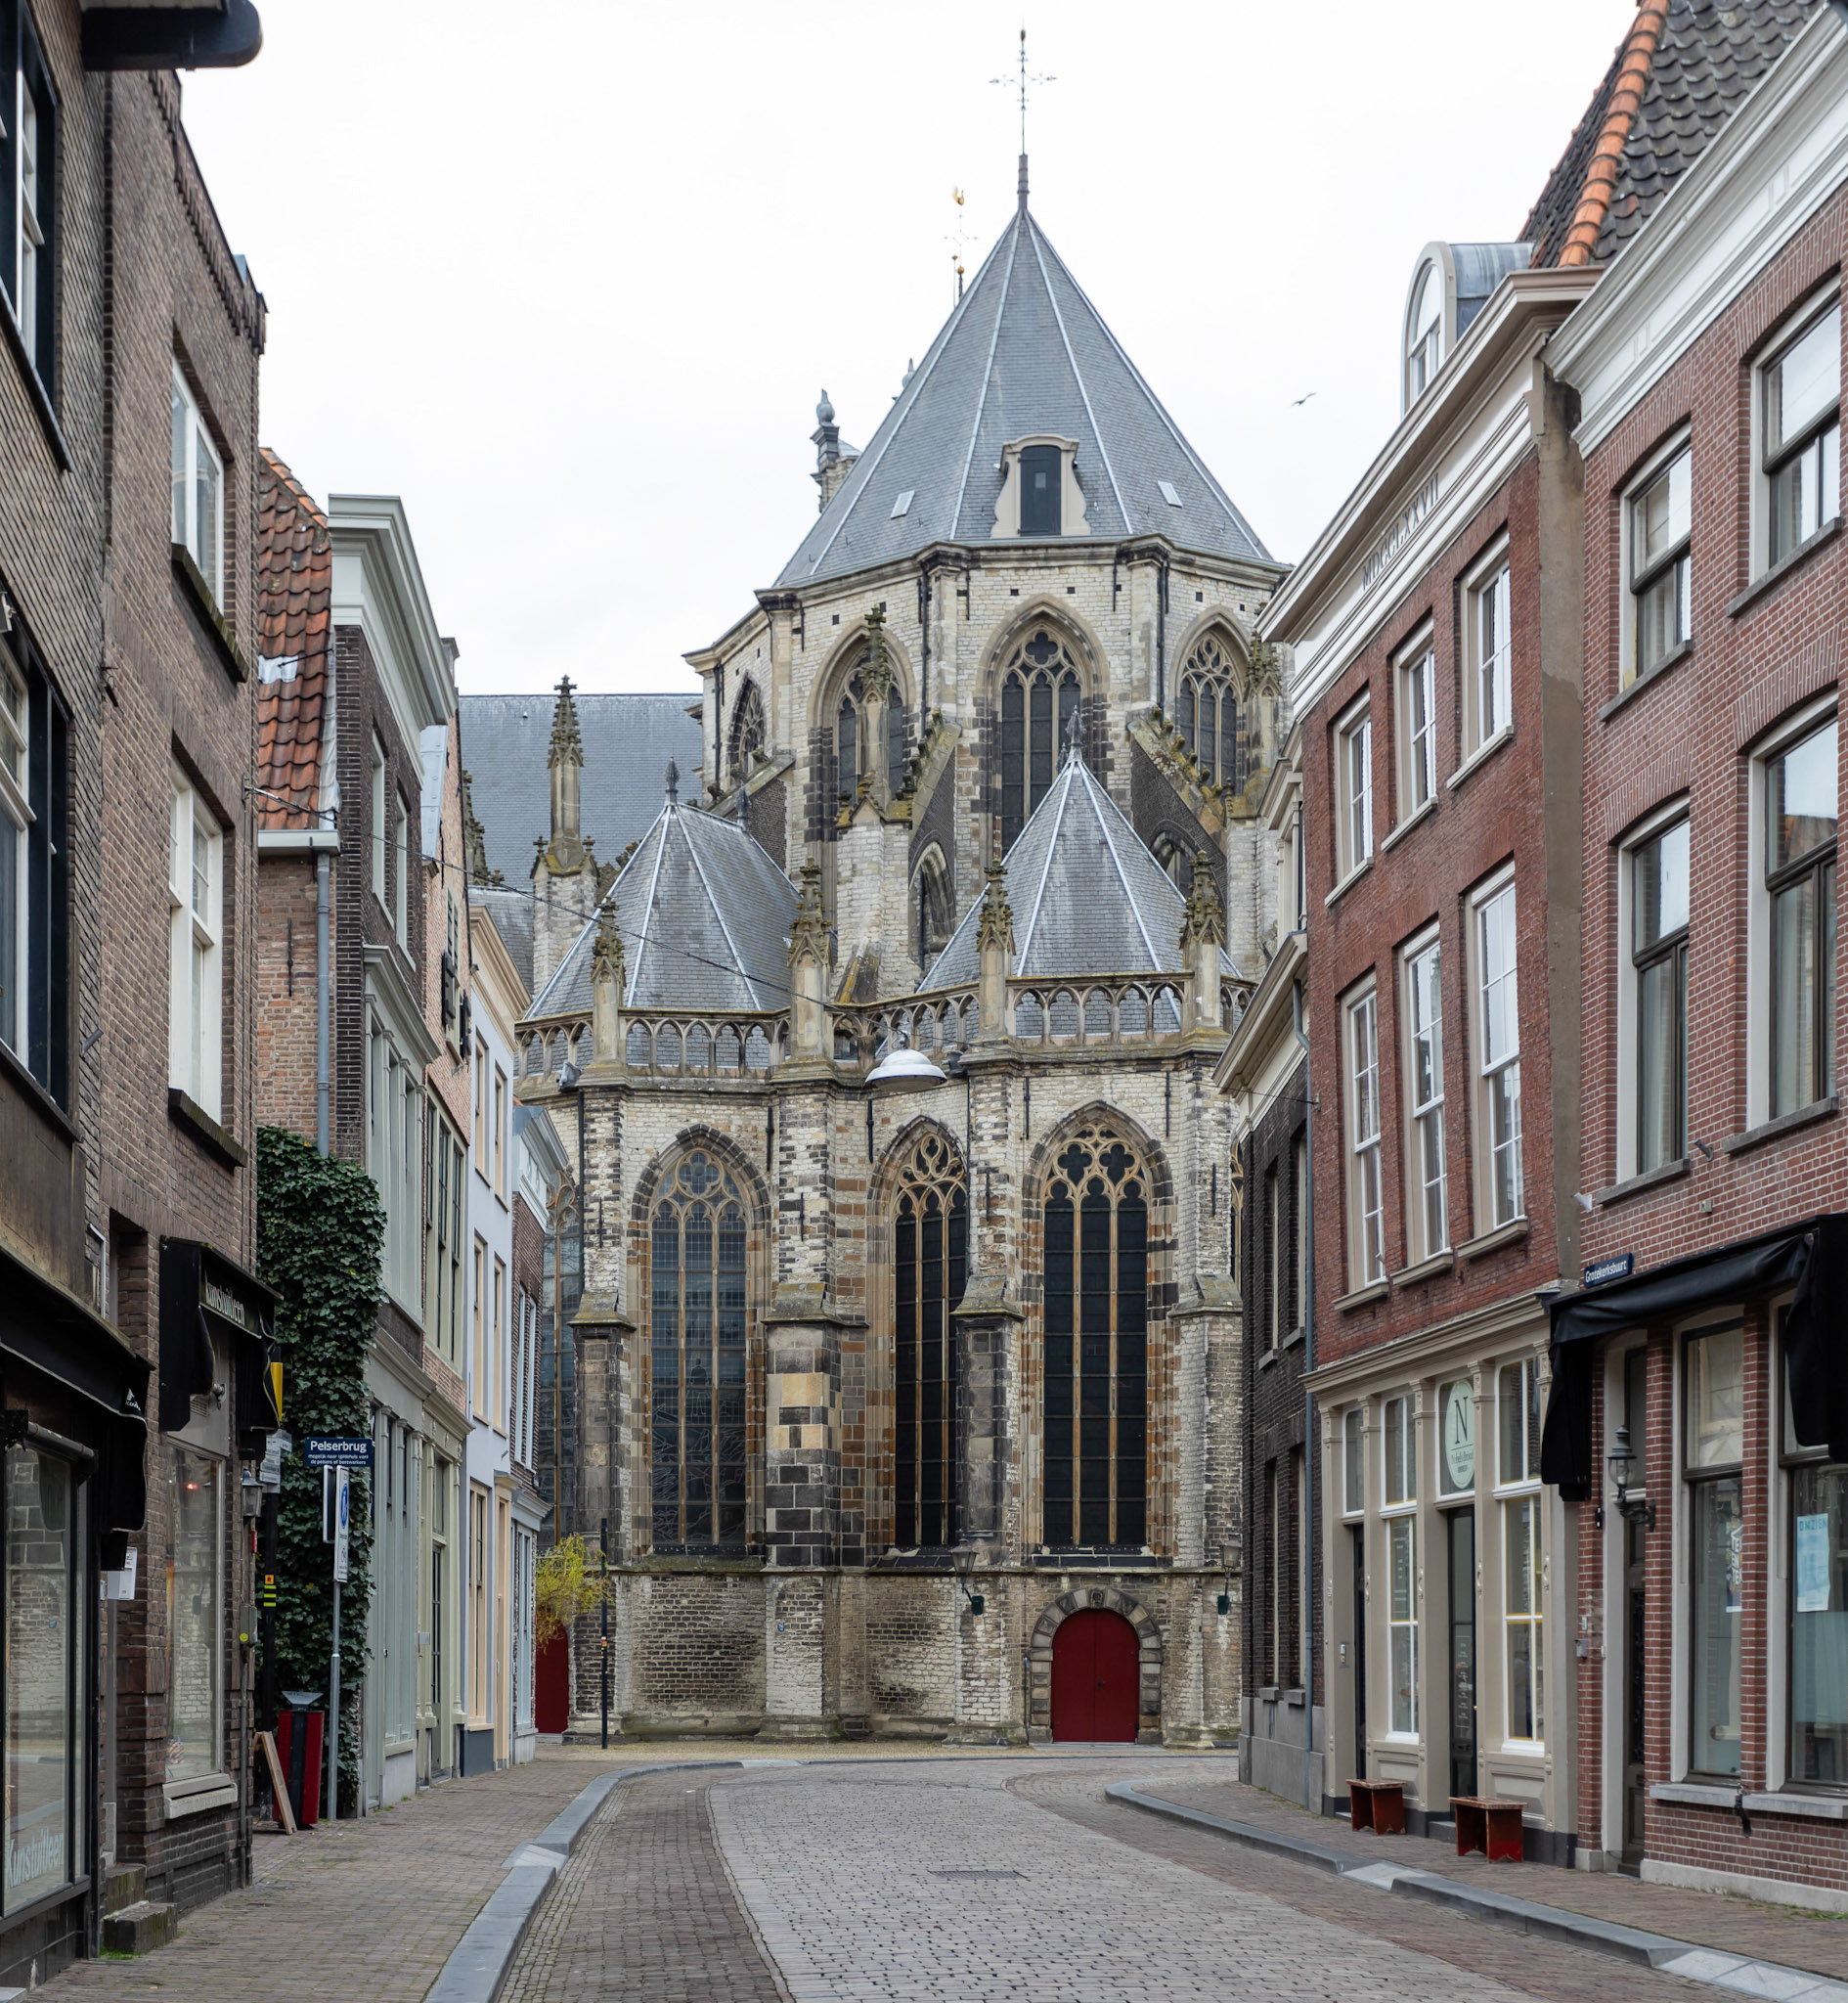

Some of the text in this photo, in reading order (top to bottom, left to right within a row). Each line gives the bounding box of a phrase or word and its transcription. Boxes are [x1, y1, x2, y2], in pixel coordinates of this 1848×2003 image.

[1362, 472, 1438, 591] MDCCLXXVII
[1585, 1260, 1627, 1283] Grotekerksbuurt
[1454, 1396, 1469, 1445] N
[310, 1440, 368, 1453] Pelserbrug
